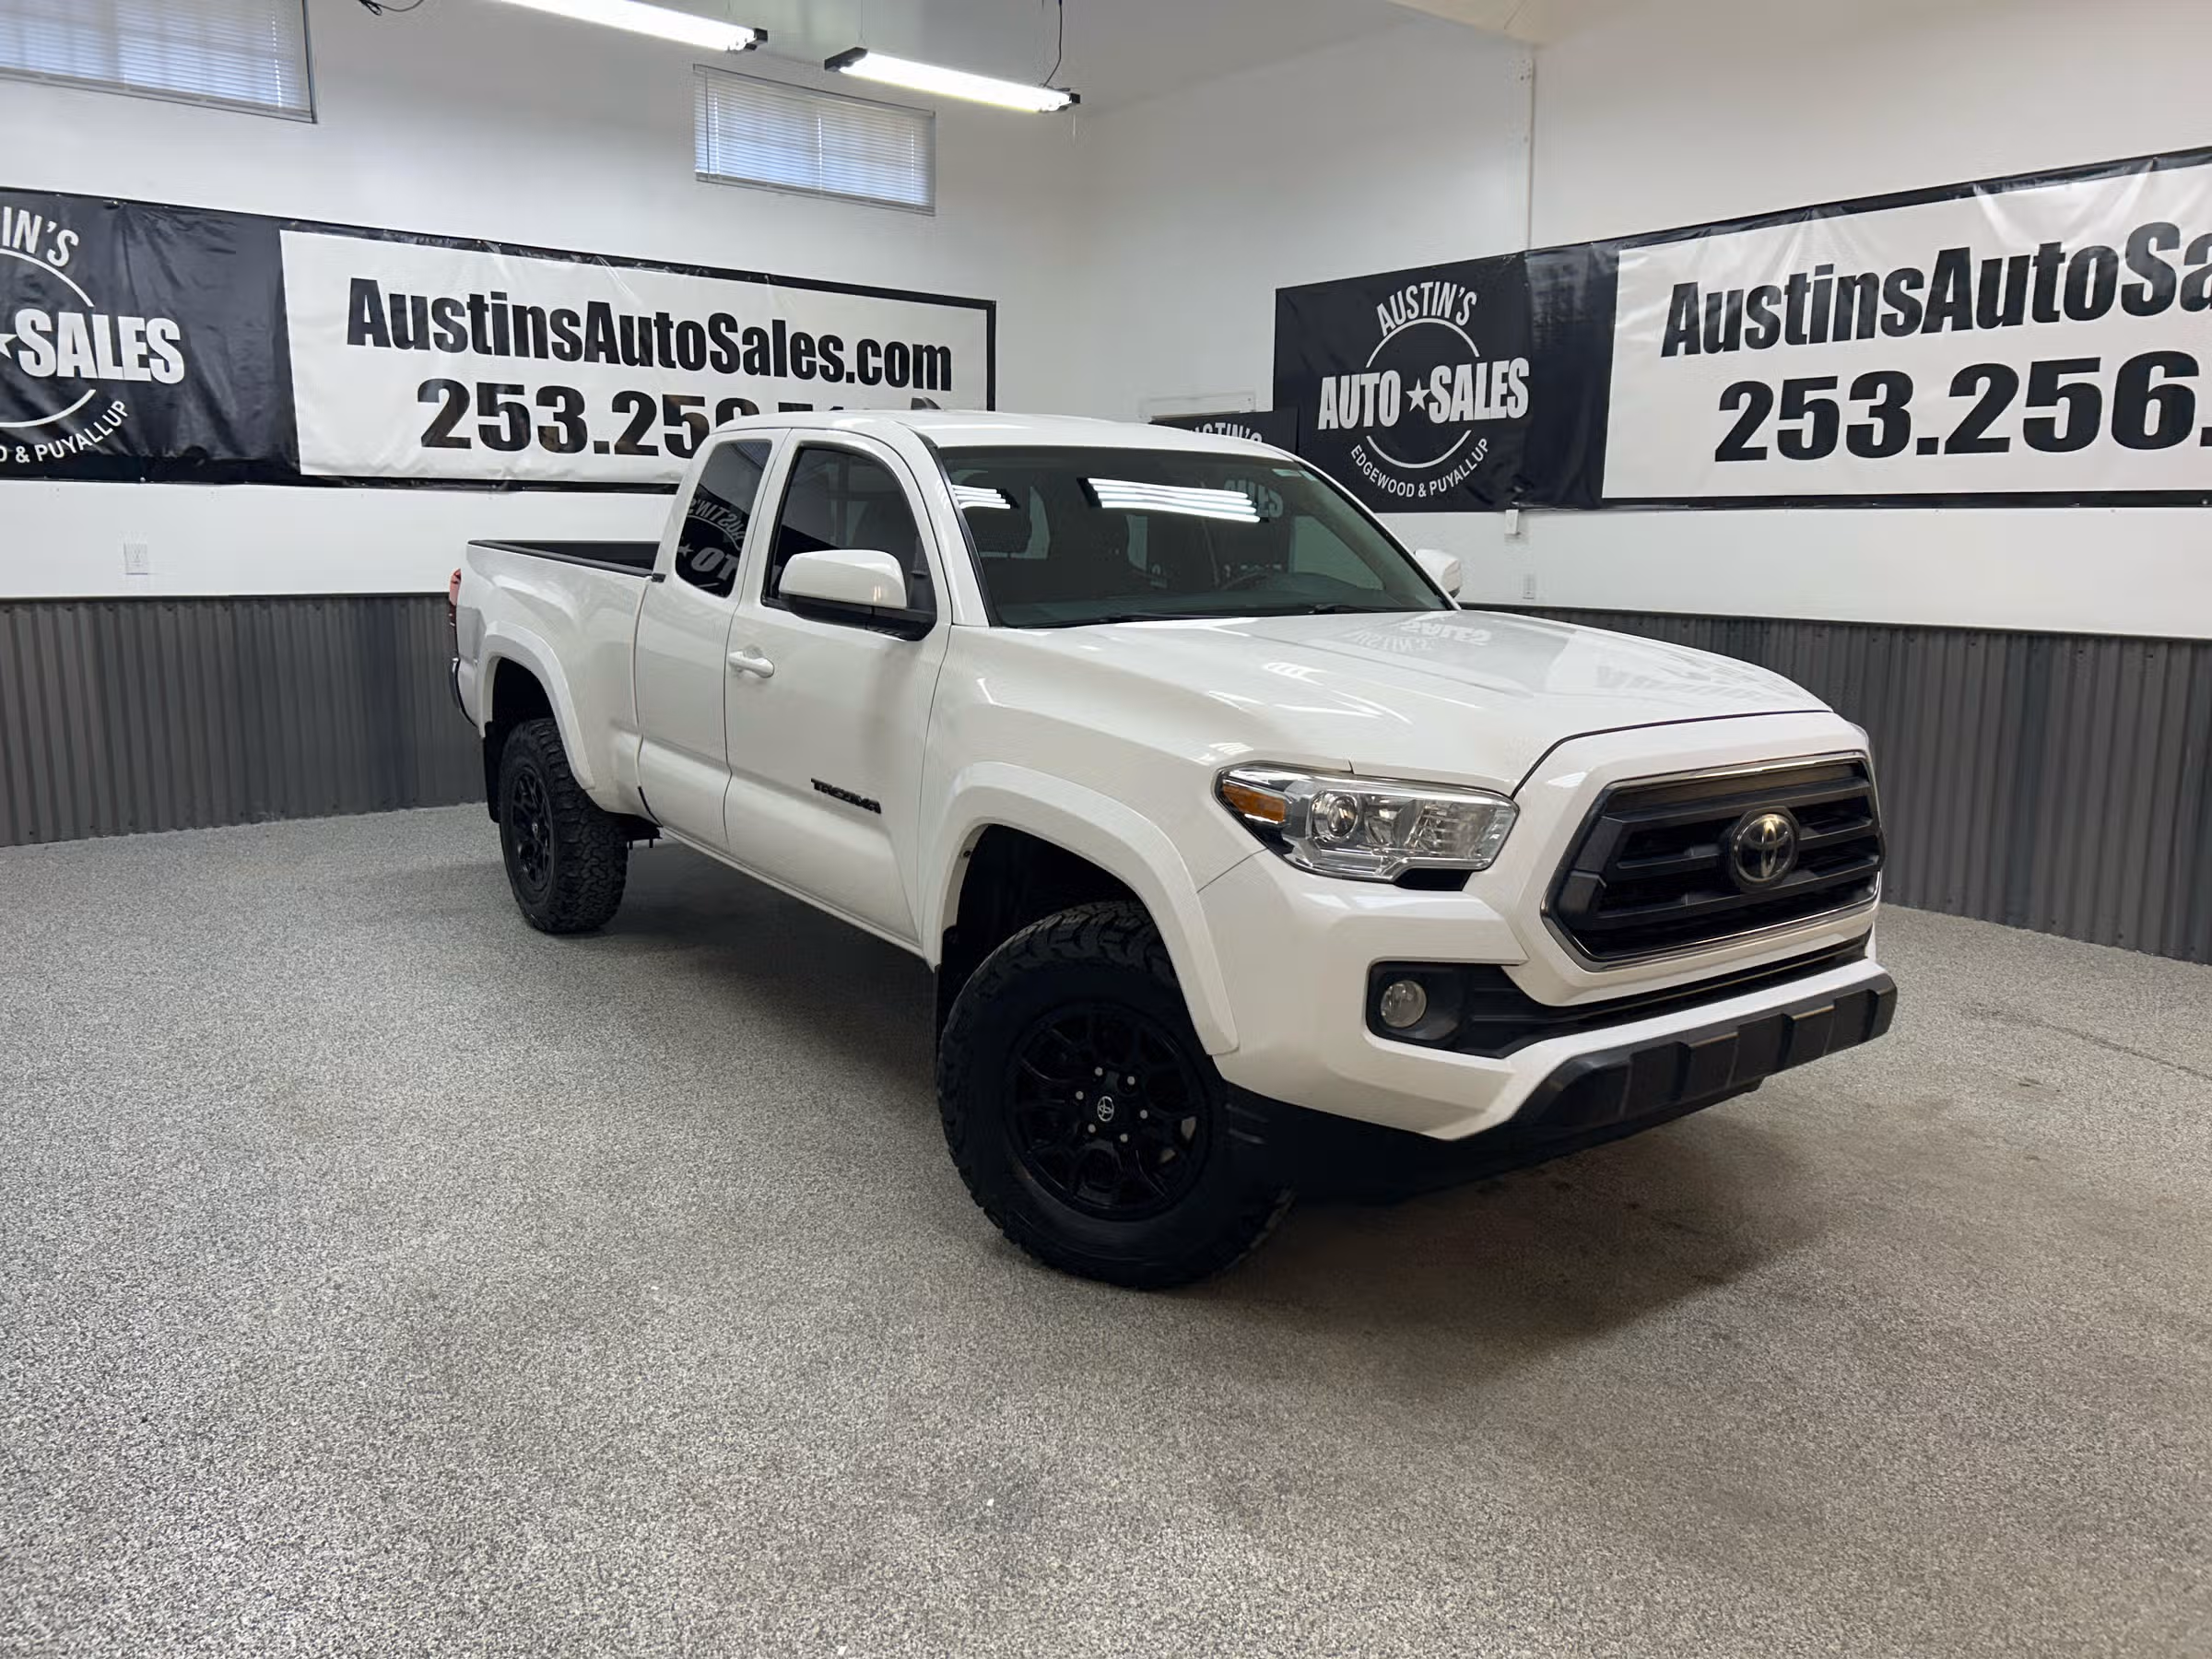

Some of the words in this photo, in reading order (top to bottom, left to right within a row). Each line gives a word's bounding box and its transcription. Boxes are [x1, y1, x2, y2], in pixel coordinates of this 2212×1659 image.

[347, 277, 952, 392] AustinsAutoSales.com
[1376, 281, 1477, 337] AUSTIN'S
[14, 308, 184, 384] SALES
[1317, 370, 1402, 430] AUTO
[1429, 358, 1530, 424] SALES
[15, 445, 30, 464] &
[34, 400, 129, 462] PUYALLUP
[1350, 444, 1415, 498] EDGEWOOD
[1418, 482, 1427, 498] &
[1429, 438, 1489, 496] PUYALLUP
